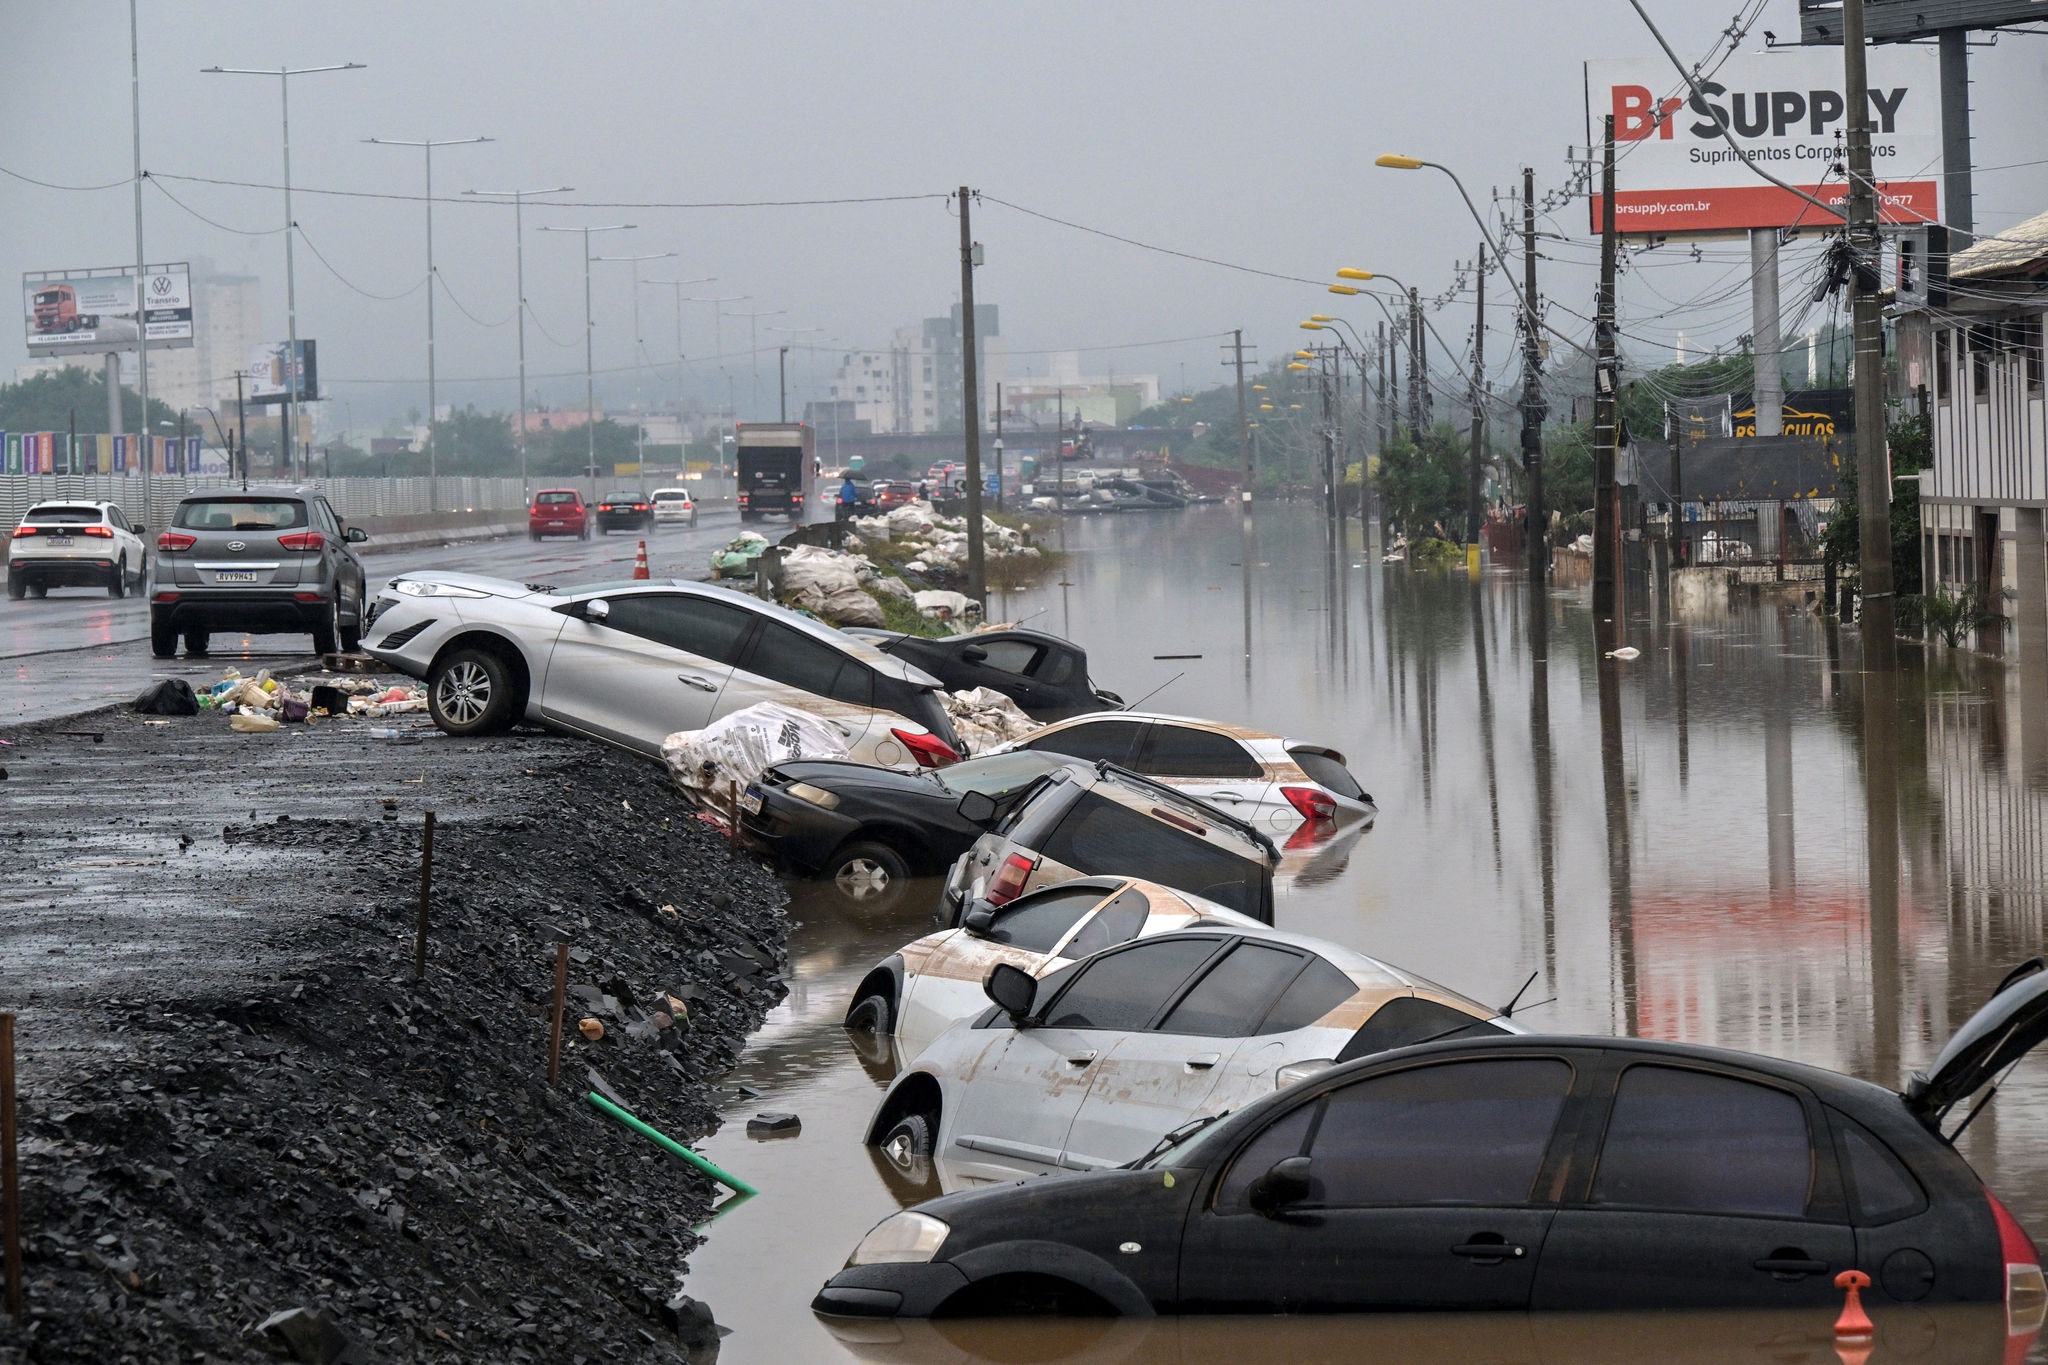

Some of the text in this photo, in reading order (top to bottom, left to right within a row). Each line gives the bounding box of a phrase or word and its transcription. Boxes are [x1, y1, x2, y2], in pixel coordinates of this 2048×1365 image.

[1611, 81, 1908, 142] BrSUPPY
[1689, 146, 1791, 166] Suprimentos
[1615, 200, 1711, 215] brsupply.com.br
[146, 296, 180, 305] Transrio
